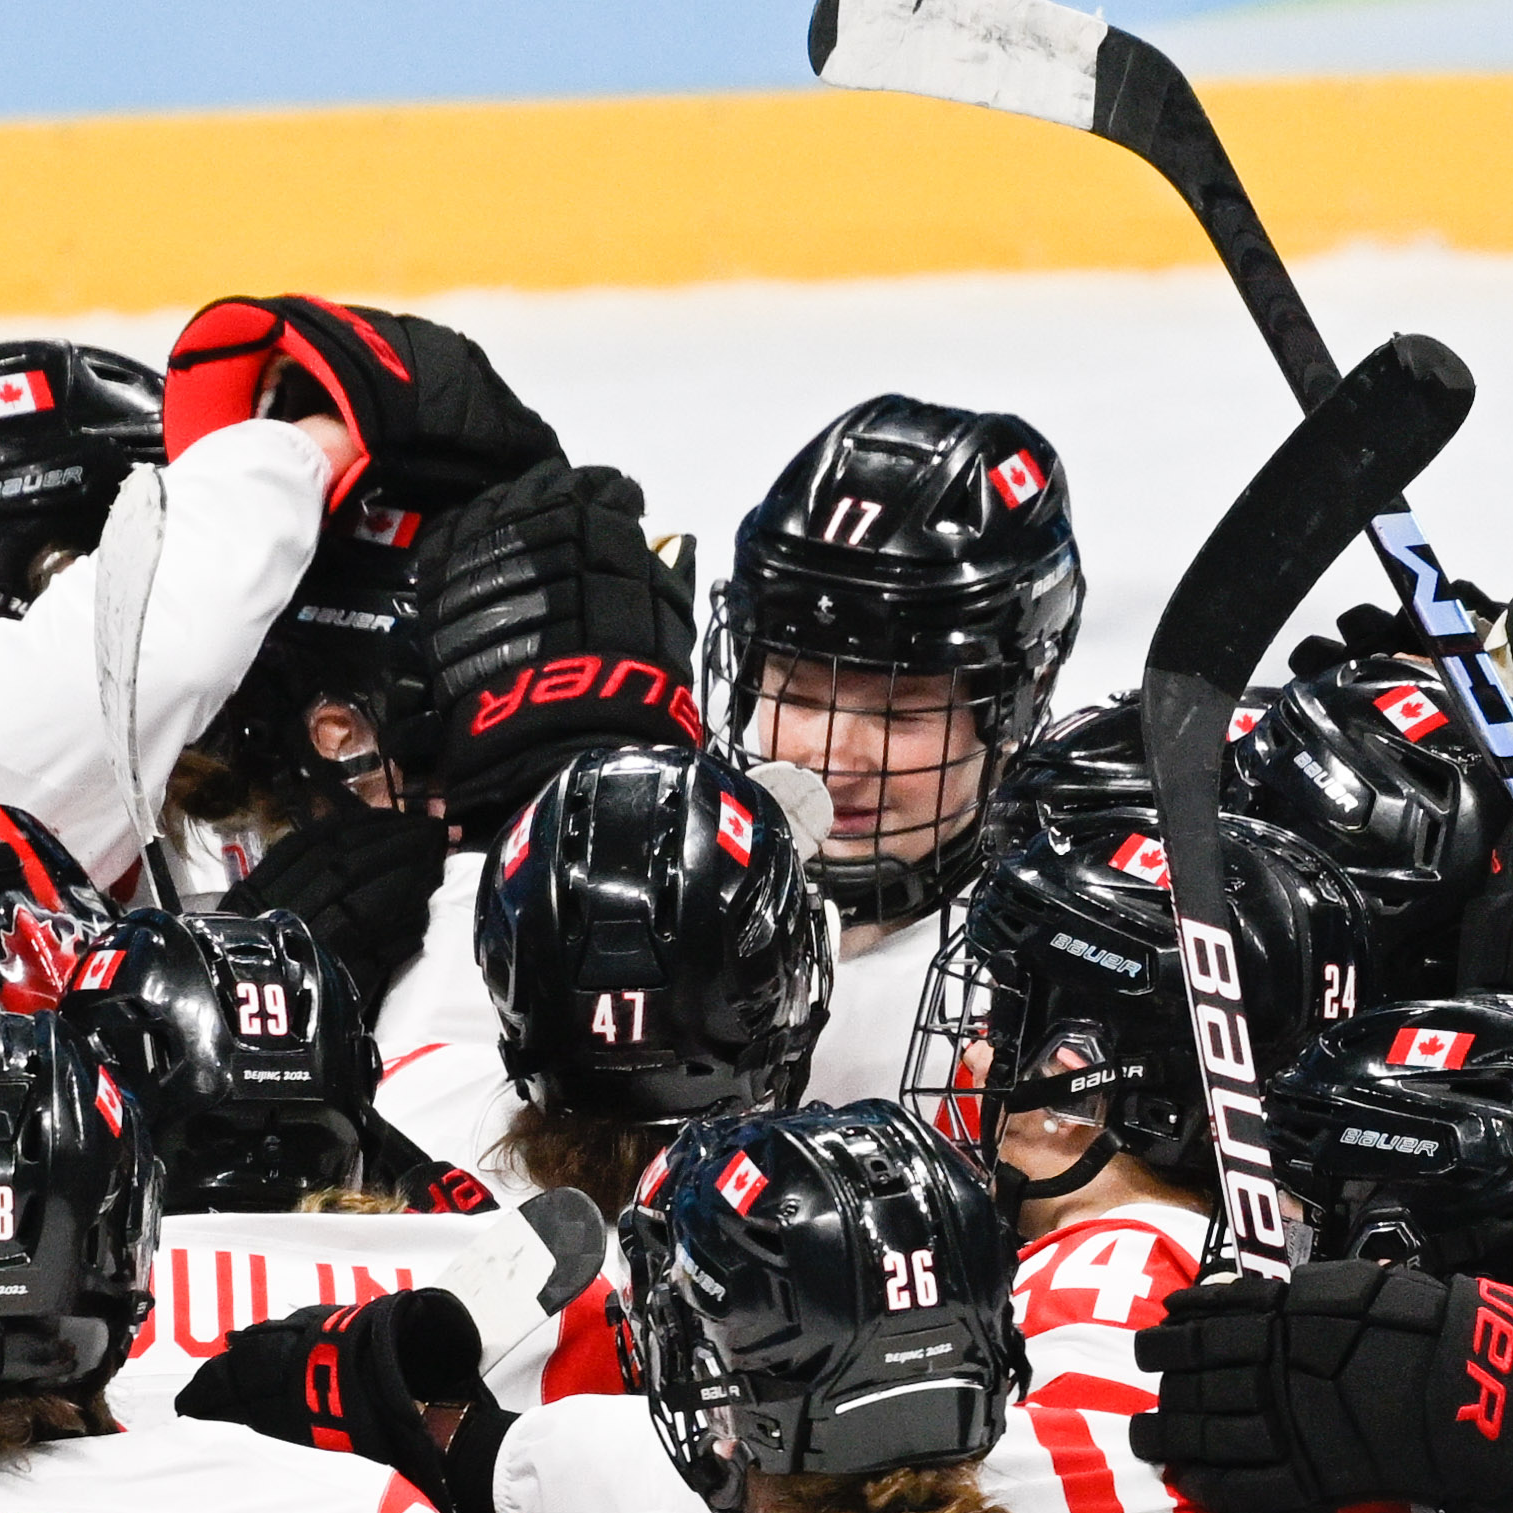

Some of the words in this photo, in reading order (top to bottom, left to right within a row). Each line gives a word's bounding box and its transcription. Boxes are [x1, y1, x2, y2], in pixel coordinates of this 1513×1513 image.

[824, 497, 884, 548] 17
[1293, 750, 1359, 814] BAUER
[1050, 932, 1143, 978] BAUER
[235, 981, 289, 1037] 29
[591, 990, 646, 1044] 47
[1323, 963, 1356, 1020] 24
[243, 1069, 281, 1083] BEIJING
[283, 1070, 312, 1082] 2022
[1340, 1127, 1439, 1157] BAUER
[883, 1249, 938, 1312] 26
